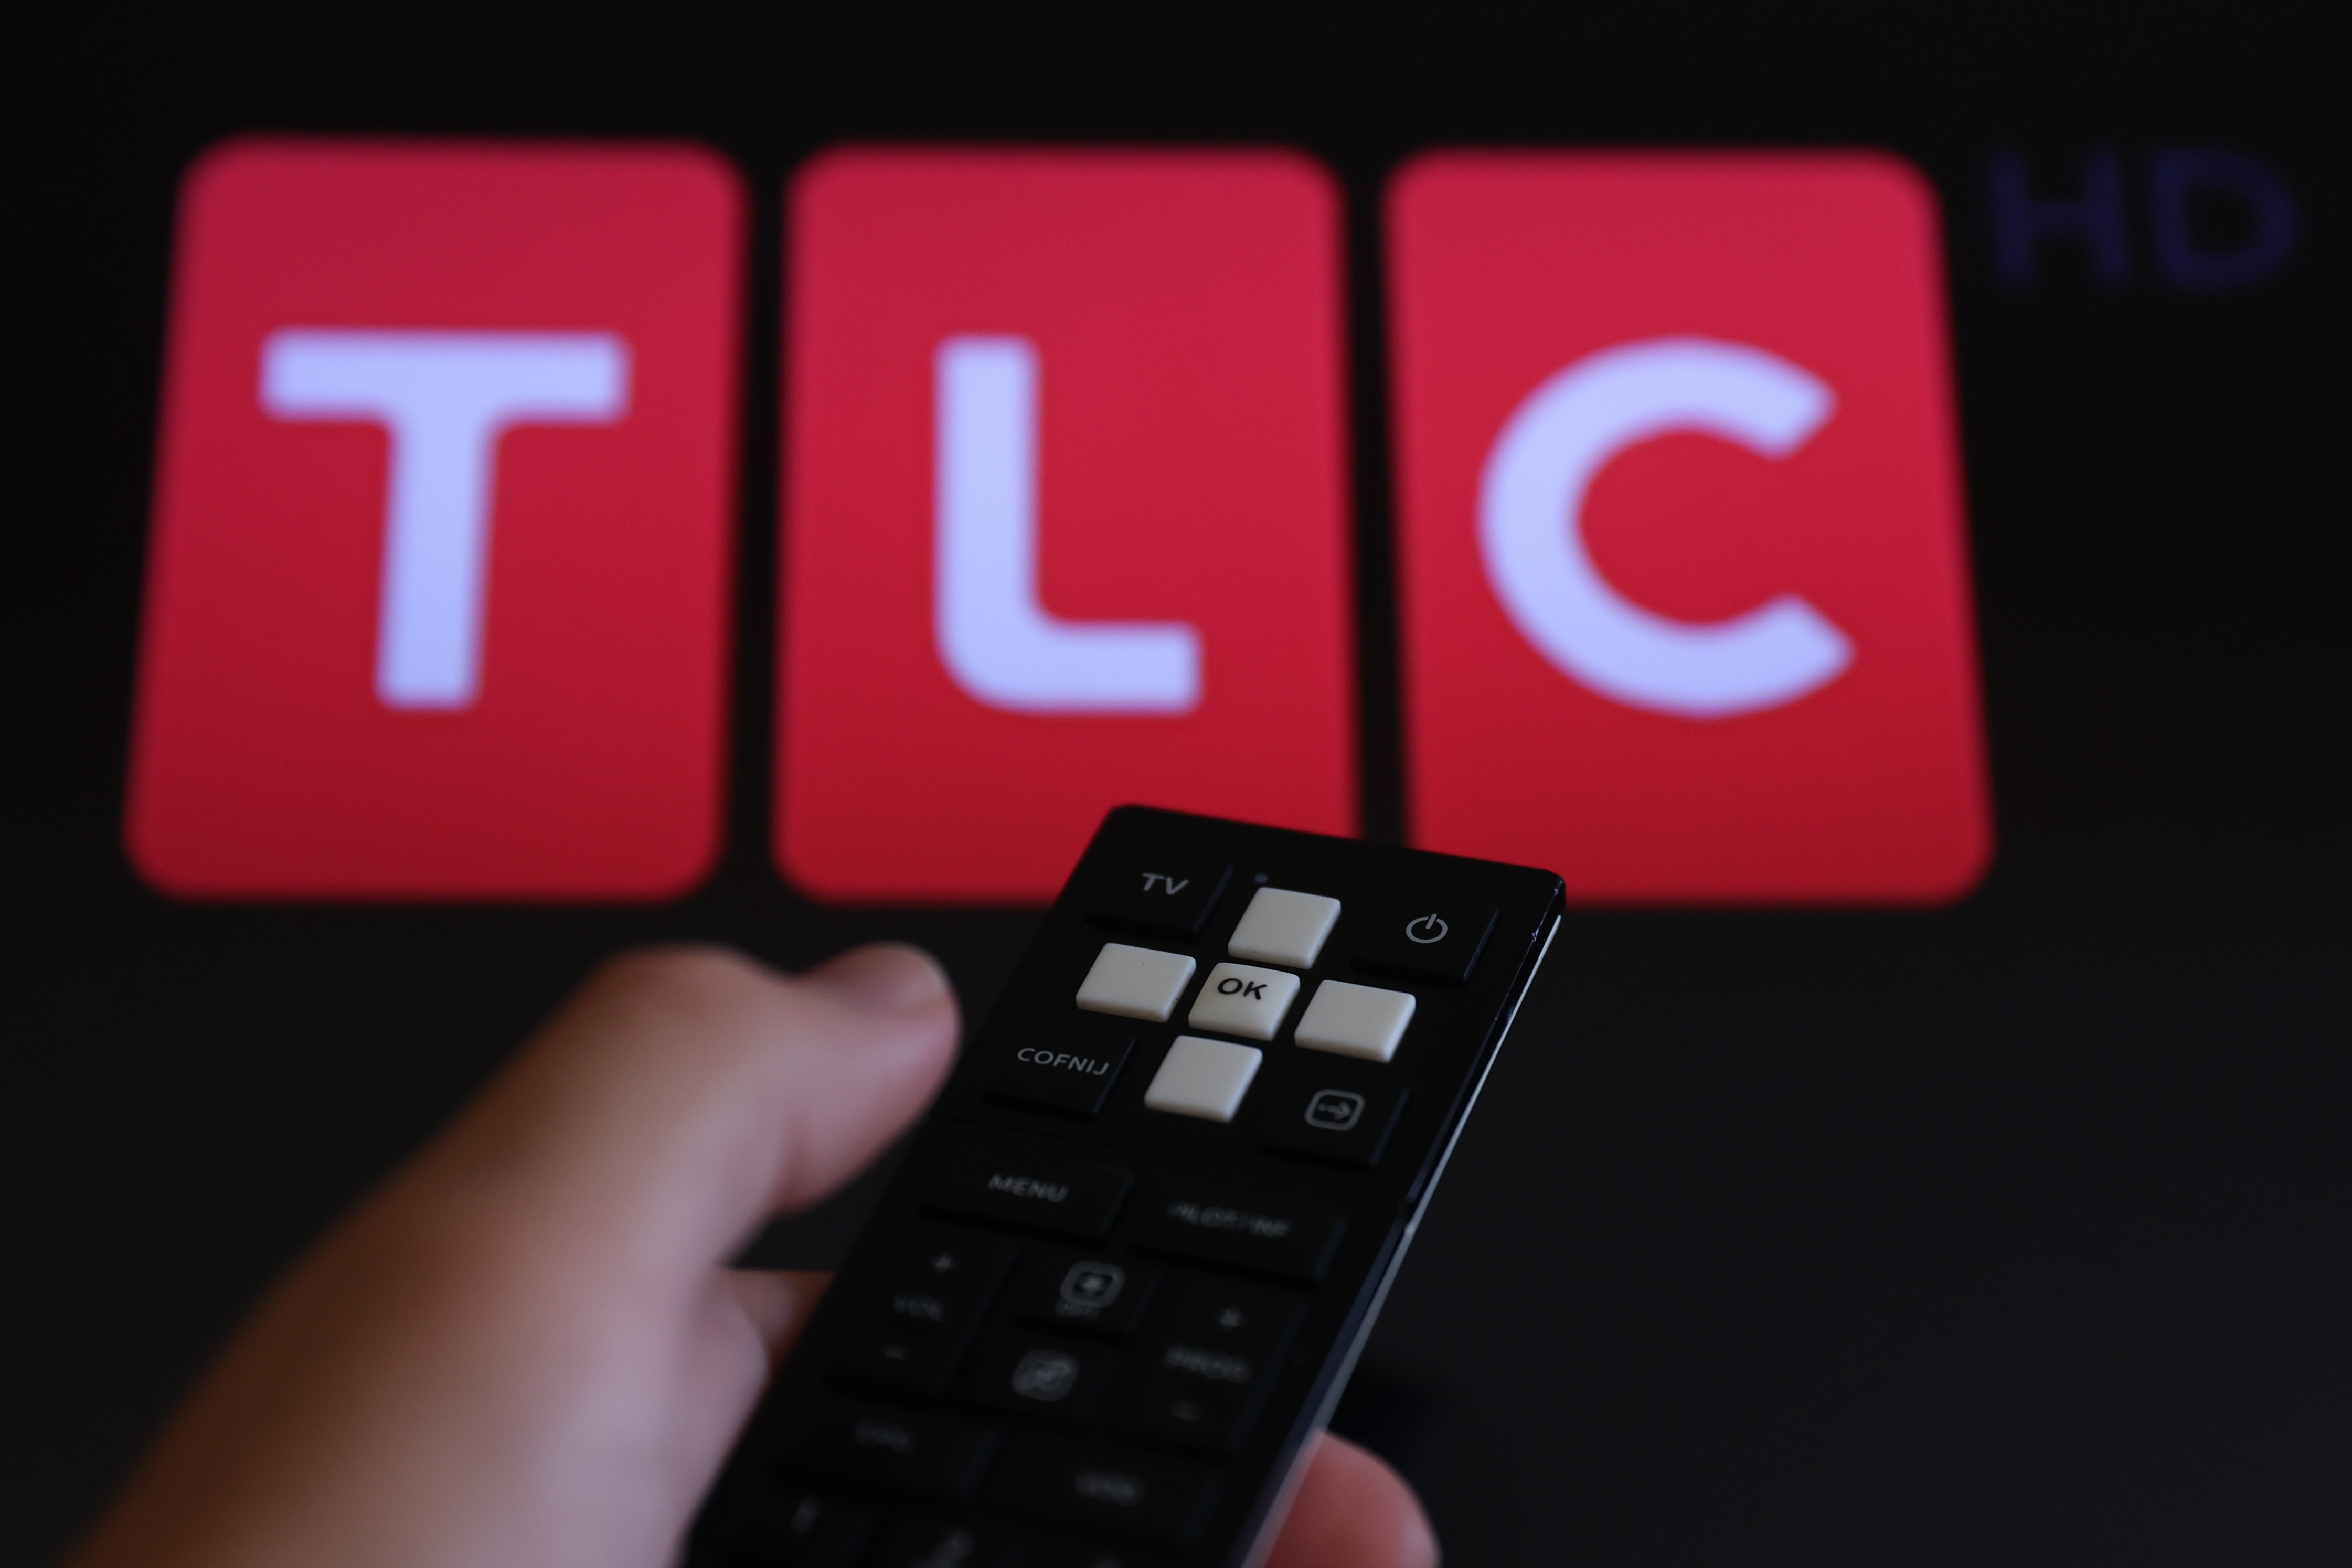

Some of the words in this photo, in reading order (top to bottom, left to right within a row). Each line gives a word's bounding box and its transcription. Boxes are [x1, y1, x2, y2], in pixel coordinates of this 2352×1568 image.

[260, 329, 1851, 716] TLC
[1986, 148, 2300, 291] HD
[1142, 872, 1189, 897] TV
[1217, 977, 1268, 1001] OK
[1016, 1047, 1110, 1076] COFNIJ
[987, 1173, 1070, 1203] MENU
